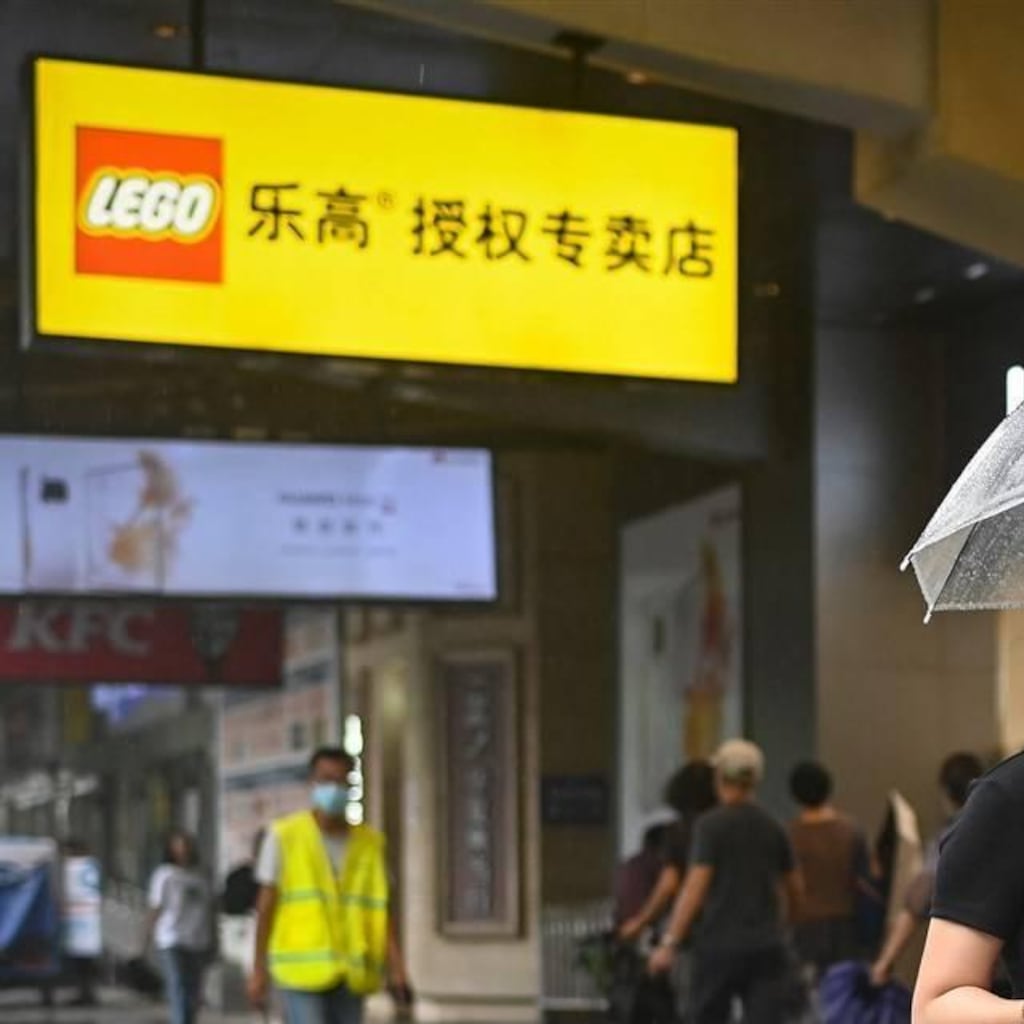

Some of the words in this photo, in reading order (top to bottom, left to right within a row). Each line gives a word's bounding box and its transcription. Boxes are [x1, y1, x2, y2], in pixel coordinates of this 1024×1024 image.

[86, 174, 215, 235] LEGO
[411, 196, 716, 279] 授权专卖店
[8, 602, 152, 657] KFC
